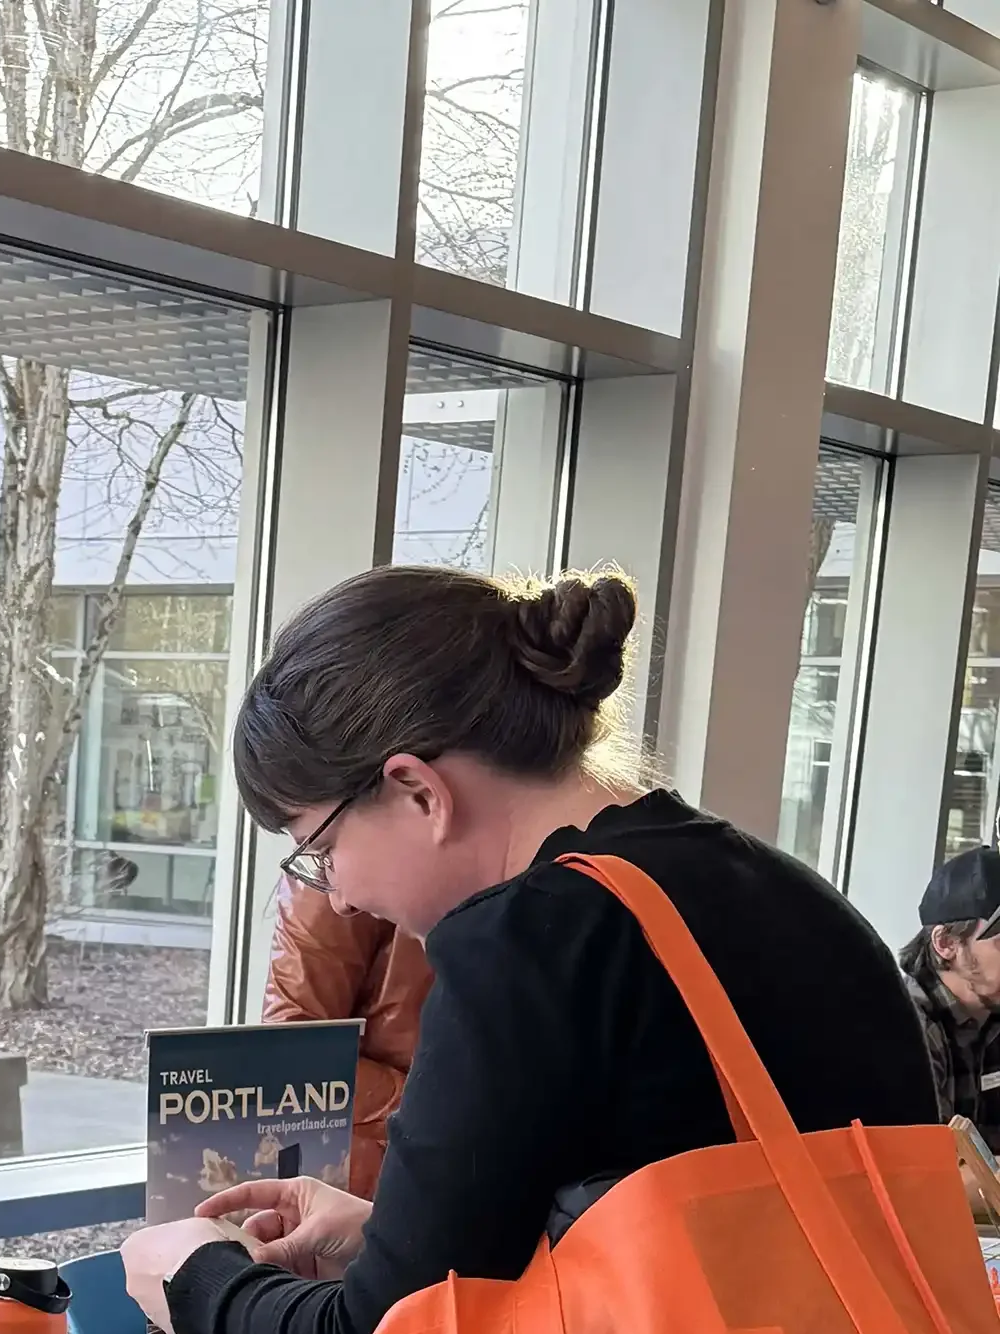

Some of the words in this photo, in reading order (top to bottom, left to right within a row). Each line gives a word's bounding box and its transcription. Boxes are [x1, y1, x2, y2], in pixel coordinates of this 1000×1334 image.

[160, 1069, 213, 1086] TRAVEL
[159, 1080, 350, 1125] PORTLAND
[257, 1117, 347, 1135] travelportland.com
